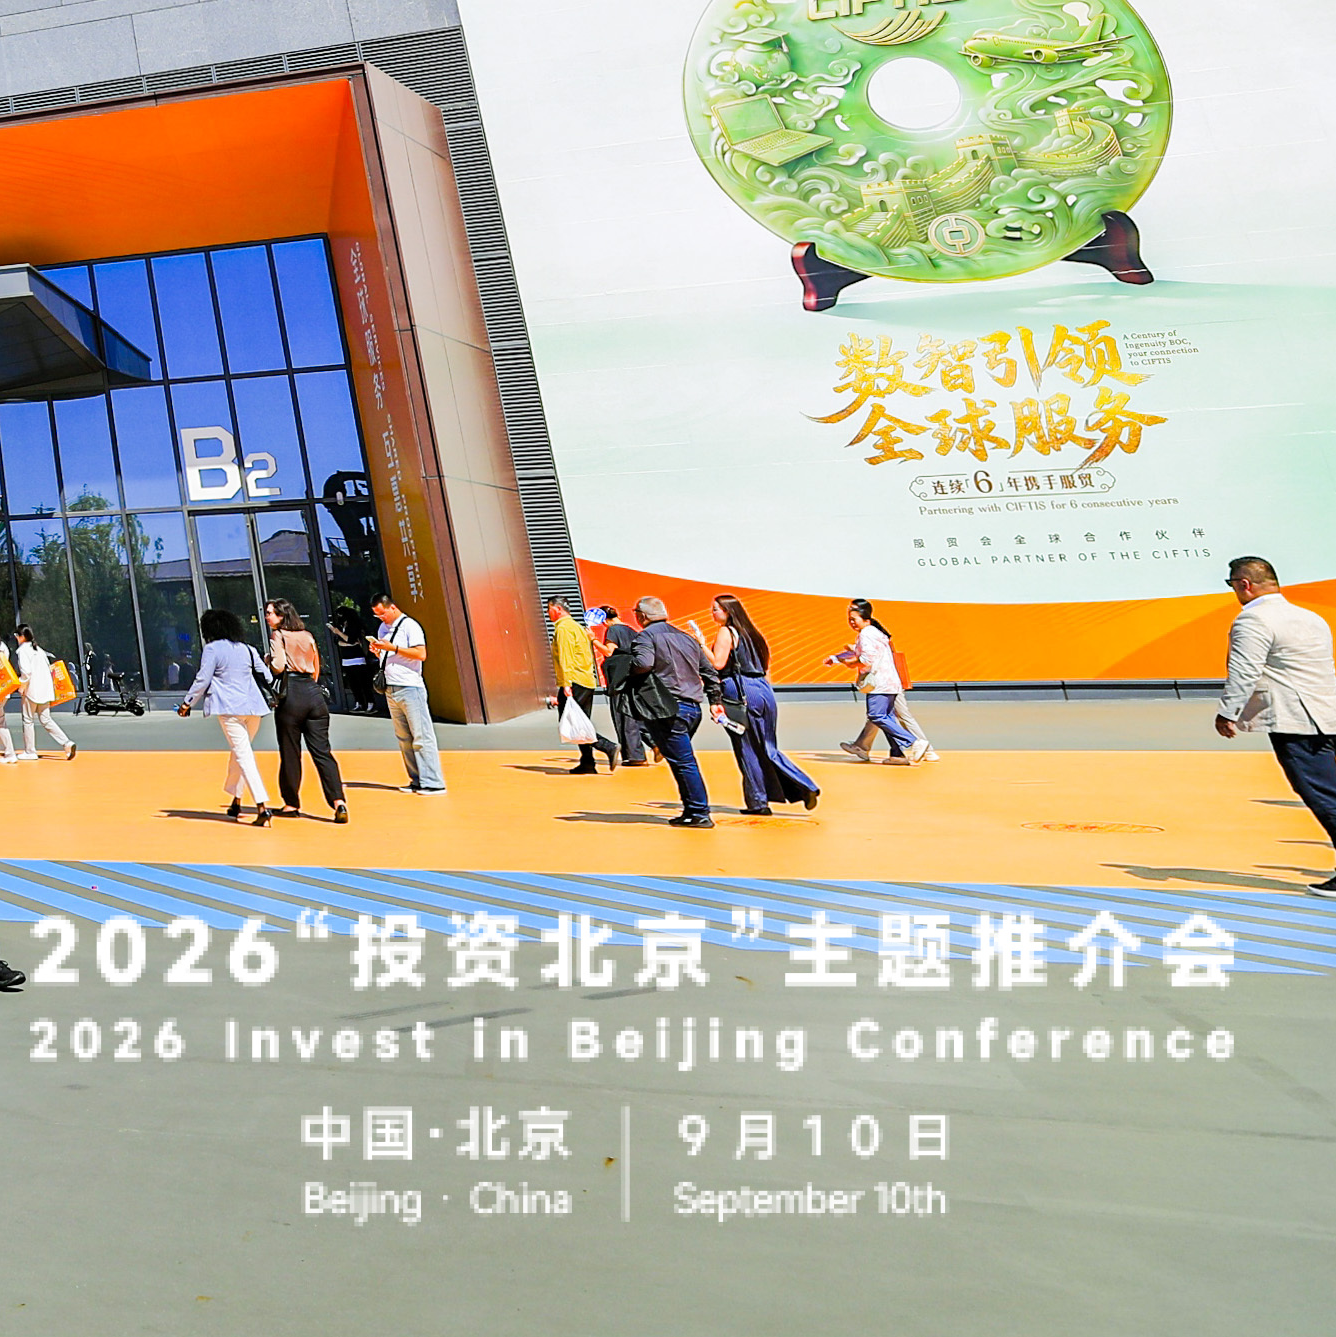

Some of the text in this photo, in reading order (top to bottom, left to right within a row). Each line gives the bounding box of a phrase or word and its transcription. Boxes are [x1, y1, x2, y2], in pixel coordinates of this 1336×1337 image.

[1125, 338, 1192, 349] Ingenuity BOC,
[1131, 331, 1166, 340] Century
[1168, 329, 1177, 337] of
[1127, 346, 1200, 359] your connection
[1141, 357, 1172, 366] CIFTIS
[800, 319, 1156, 424] 数智引领
[845, 385, 1169, 475] 全球服务
[180, 425, 282, 501] B2
[918, 496, 1179, 516] Partnering with CIFTIS for 6 consecutive years
[913, 527, 1206, 549] 服贸会全球合作伙伴
[917, 548, 1212, 567] GLOBAL PARTNER OF THE CIFTIS
